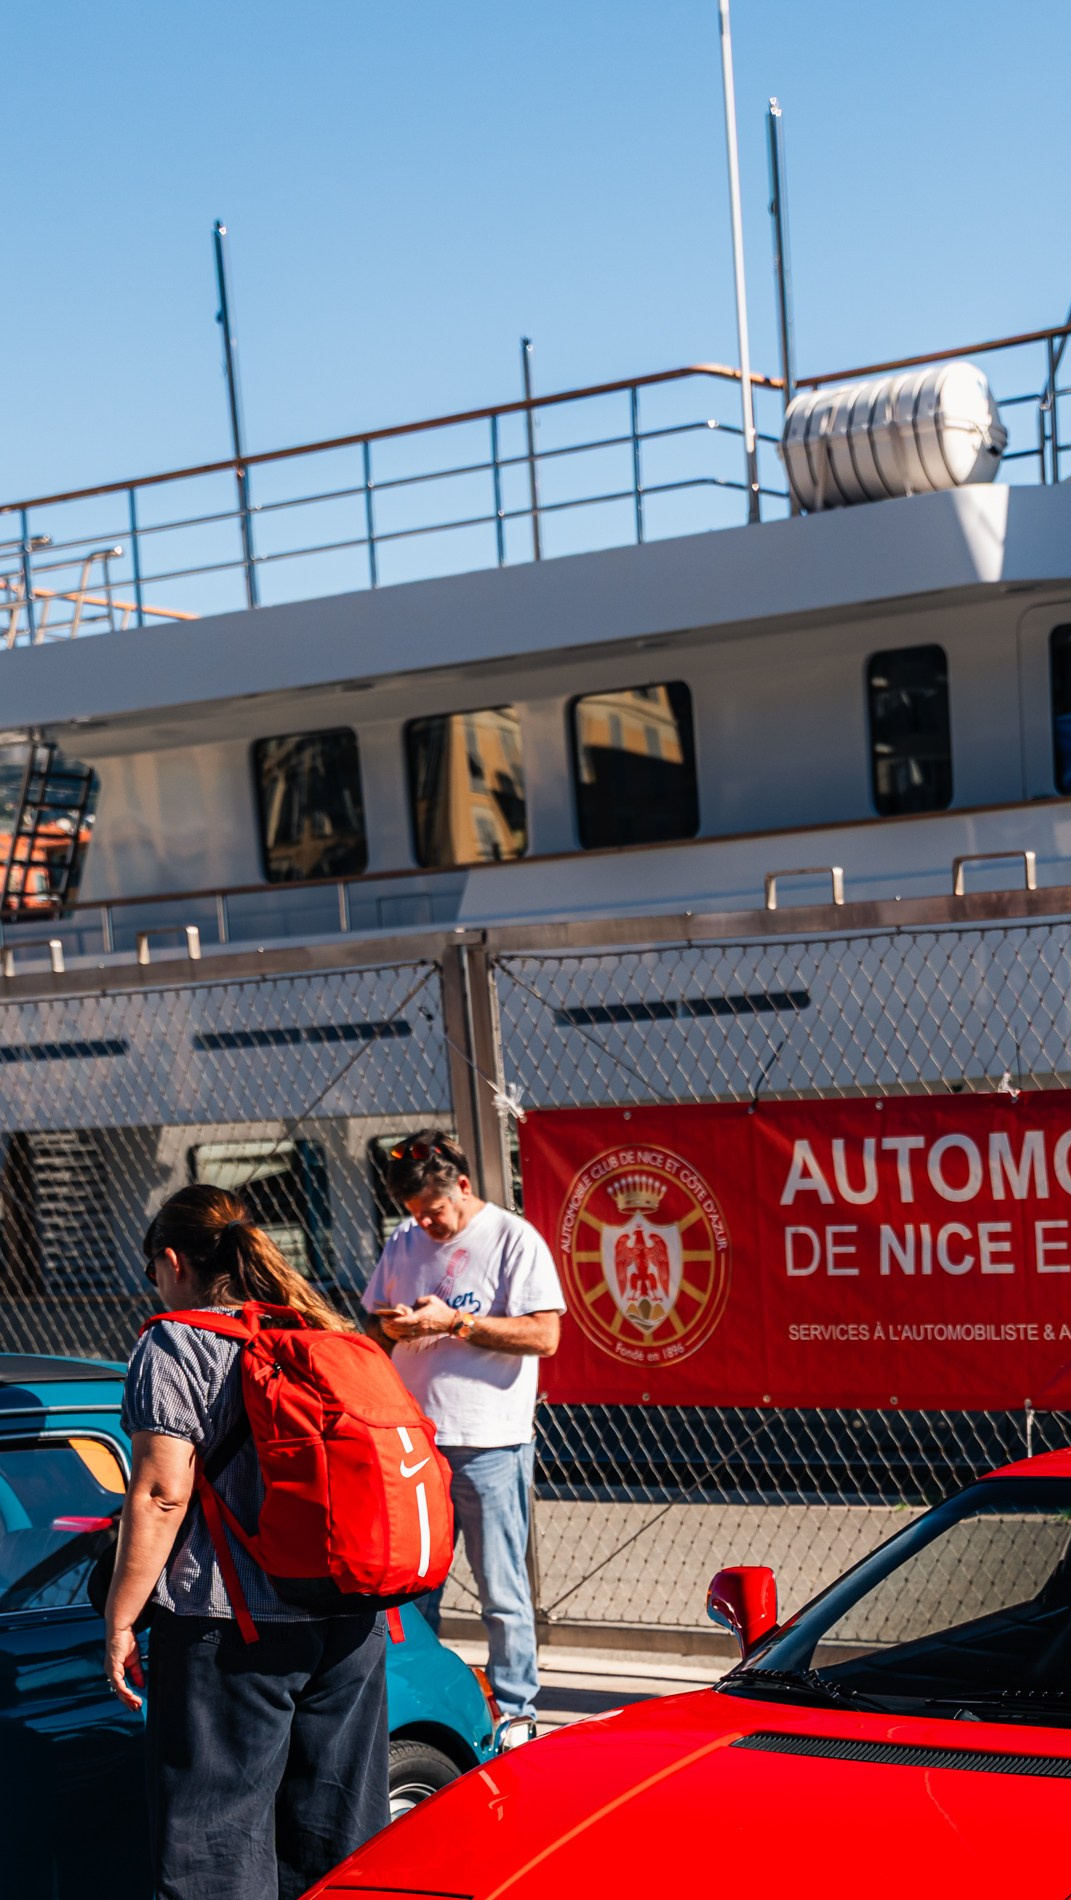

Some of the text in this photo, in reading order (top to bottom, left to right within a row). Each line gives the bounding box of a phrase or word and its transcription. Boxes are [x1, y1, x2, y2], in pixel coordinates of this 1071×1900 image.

[560, 1151, 728, 1254] AUTOMOBILE CLUB DE NICE ET CÔTE D'AZUR
[784, 1225, 860, 1277] DE
[879, 1222, 1015, 1276] NICE
[788, 1324, 870, 1341] SERVICES
[873, 1321, 886, 1341] À
[889, 1323, 1039, 1341] L'AUTOMOBILISTE
[1043, 1323, 1056, 1341] &
[647, 1352, 660, 1362] en
